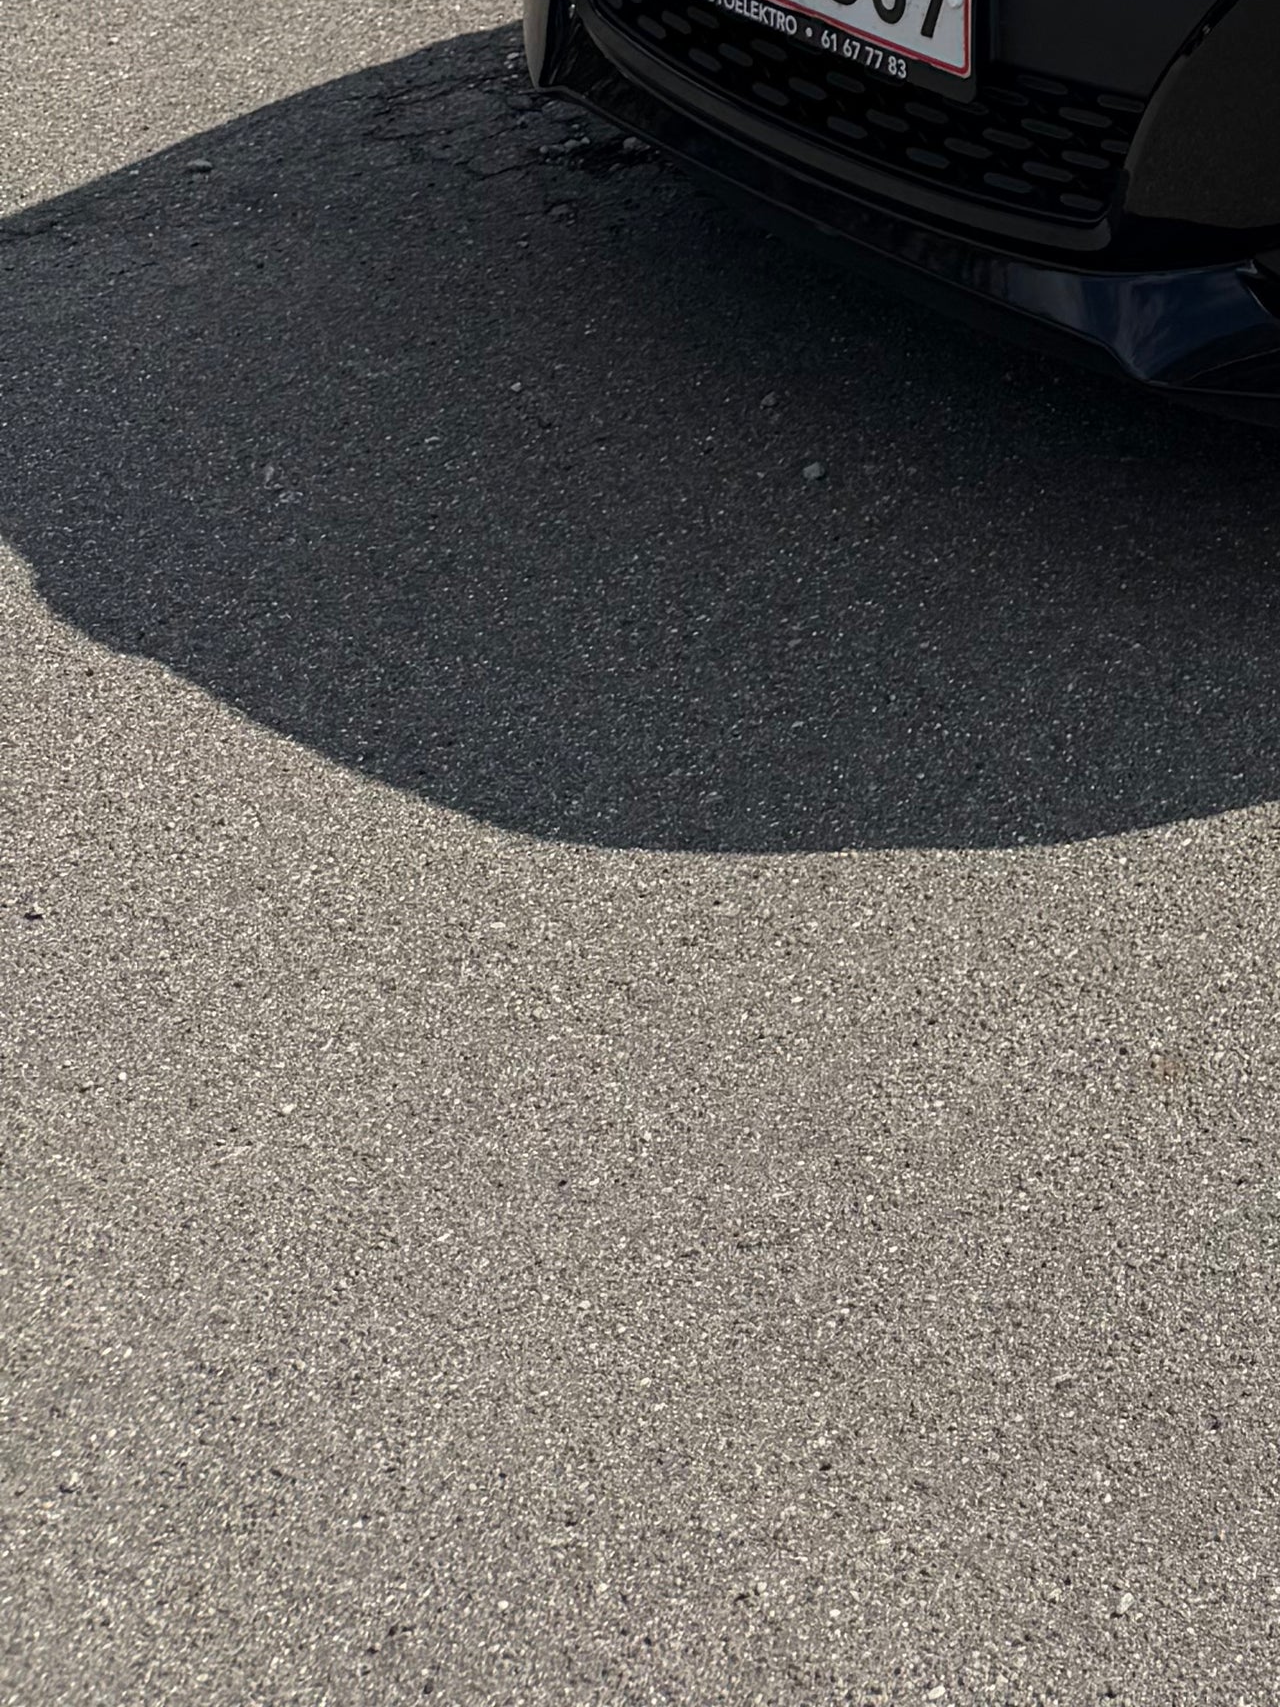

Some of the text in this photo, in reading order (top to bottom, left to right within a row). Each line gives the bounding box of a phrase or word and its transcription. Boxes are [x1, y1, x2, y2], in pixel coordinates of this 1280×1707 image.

[820, 28, 838, 53] 61
[842, 37, 860, 62] 67
[864, 45, 884, 70] 77
[887, 53, 908, 80] 83
